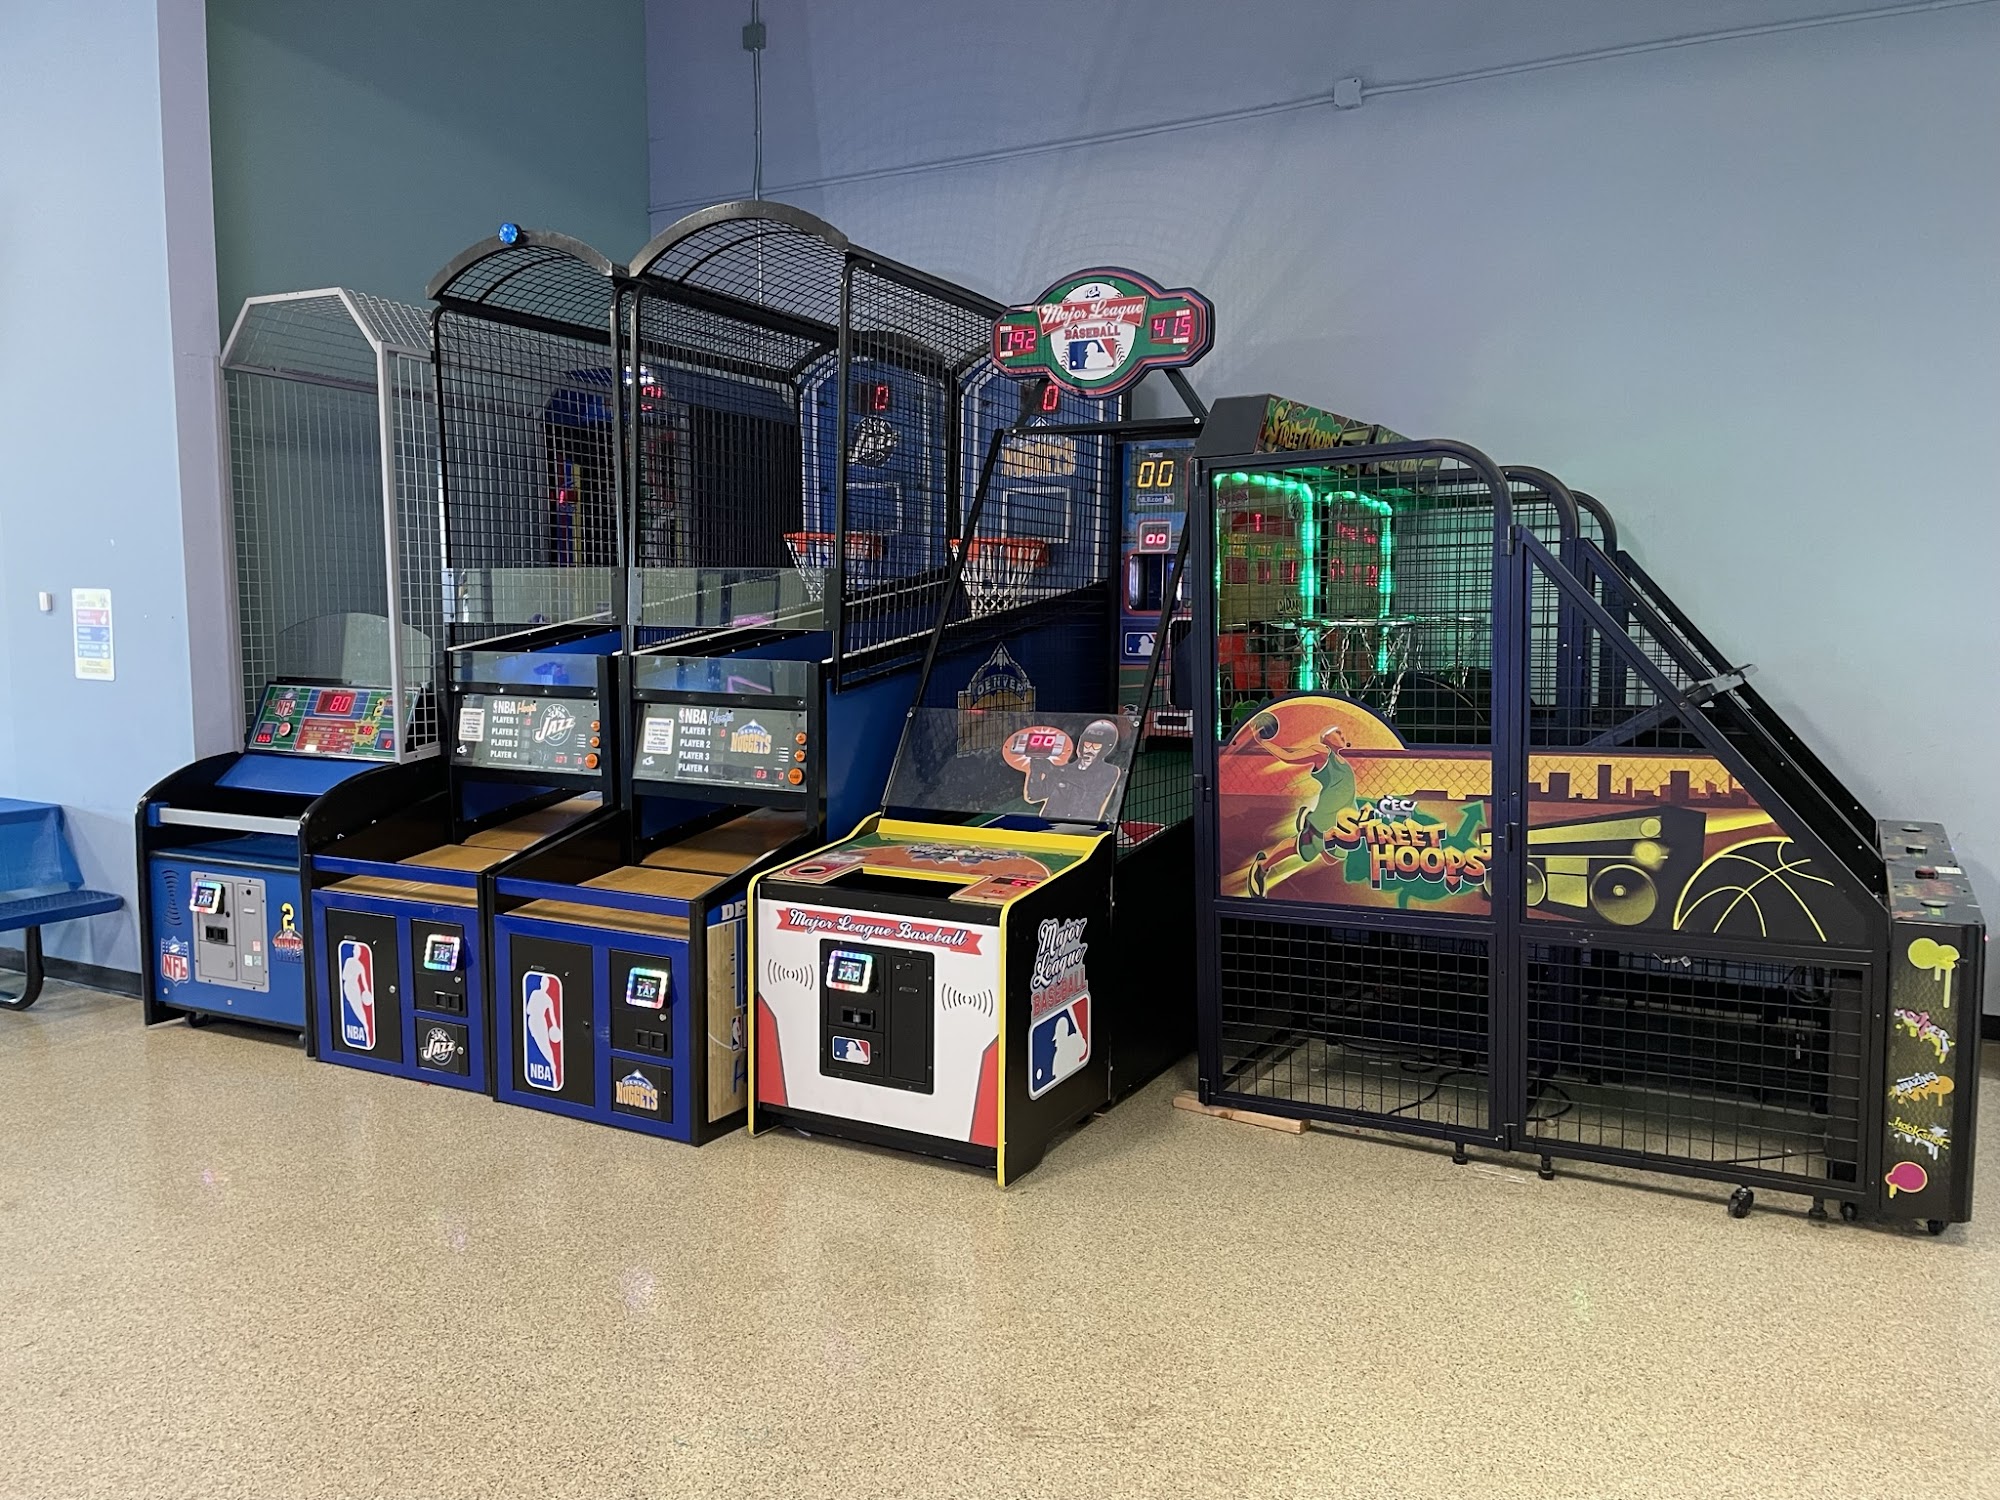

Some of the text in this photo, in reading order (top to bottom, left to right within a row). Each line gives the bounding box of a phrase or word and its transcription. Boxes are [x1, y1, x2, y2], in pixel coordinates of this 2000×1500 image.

[1041, 300, 1144, 327] Major League
[1008, 329, 1036, 350] 192
[1064, 325, 1121, 340] BASEBALL
[1137, 460, 1175, 488] 00
[1145, 533, 1166, 545] 00
[977, 677, 1026, 695] DENVER
[330, 695, 351, 712] 80
[498, 701, 516, 714] NBA
[492, 716, 514, 724] PLAYER
[686, 708, 707, 725] NBA
[491, 727, 518, 736] PLAYER 2
[681, 726, 711, 736] PLAYER 1
[490, 739, 518, 747] PLAYER 3
[680, 739, 711, 749] PLAYER 2
[730, 732, 773, 754] NUGGETS
[490, 750, 517, 759] PLAYER 4
[679, 752, 710, 761] PLAYER 3
[678, 763, 709, 773] PLAYER 4
[1323, 805, 1447, 848] STREET
[1370, 844, 1492, 890] HOOPS
[198, 895, 212, 904] TAP
[281, 902, 295, 932] 2
[789, 909, 967, 947] Major League Baseball
[1040, 922, 1087, 956] Major
[433, 950, 450, 960] TAP
[163, 954, 188, 981] NFL
[838, 968, 860, 979] TAP
[1033, 946, 1087, 989] League
[637, 985, 656, 997] TAP
[1033, 967, 1087, 1017] BASEBALL
[346, 1024, 366, 1041] NBA
[530, 1063, 552, 1081] NBA
[616, 1081, 658, 1111] NUGGETS
